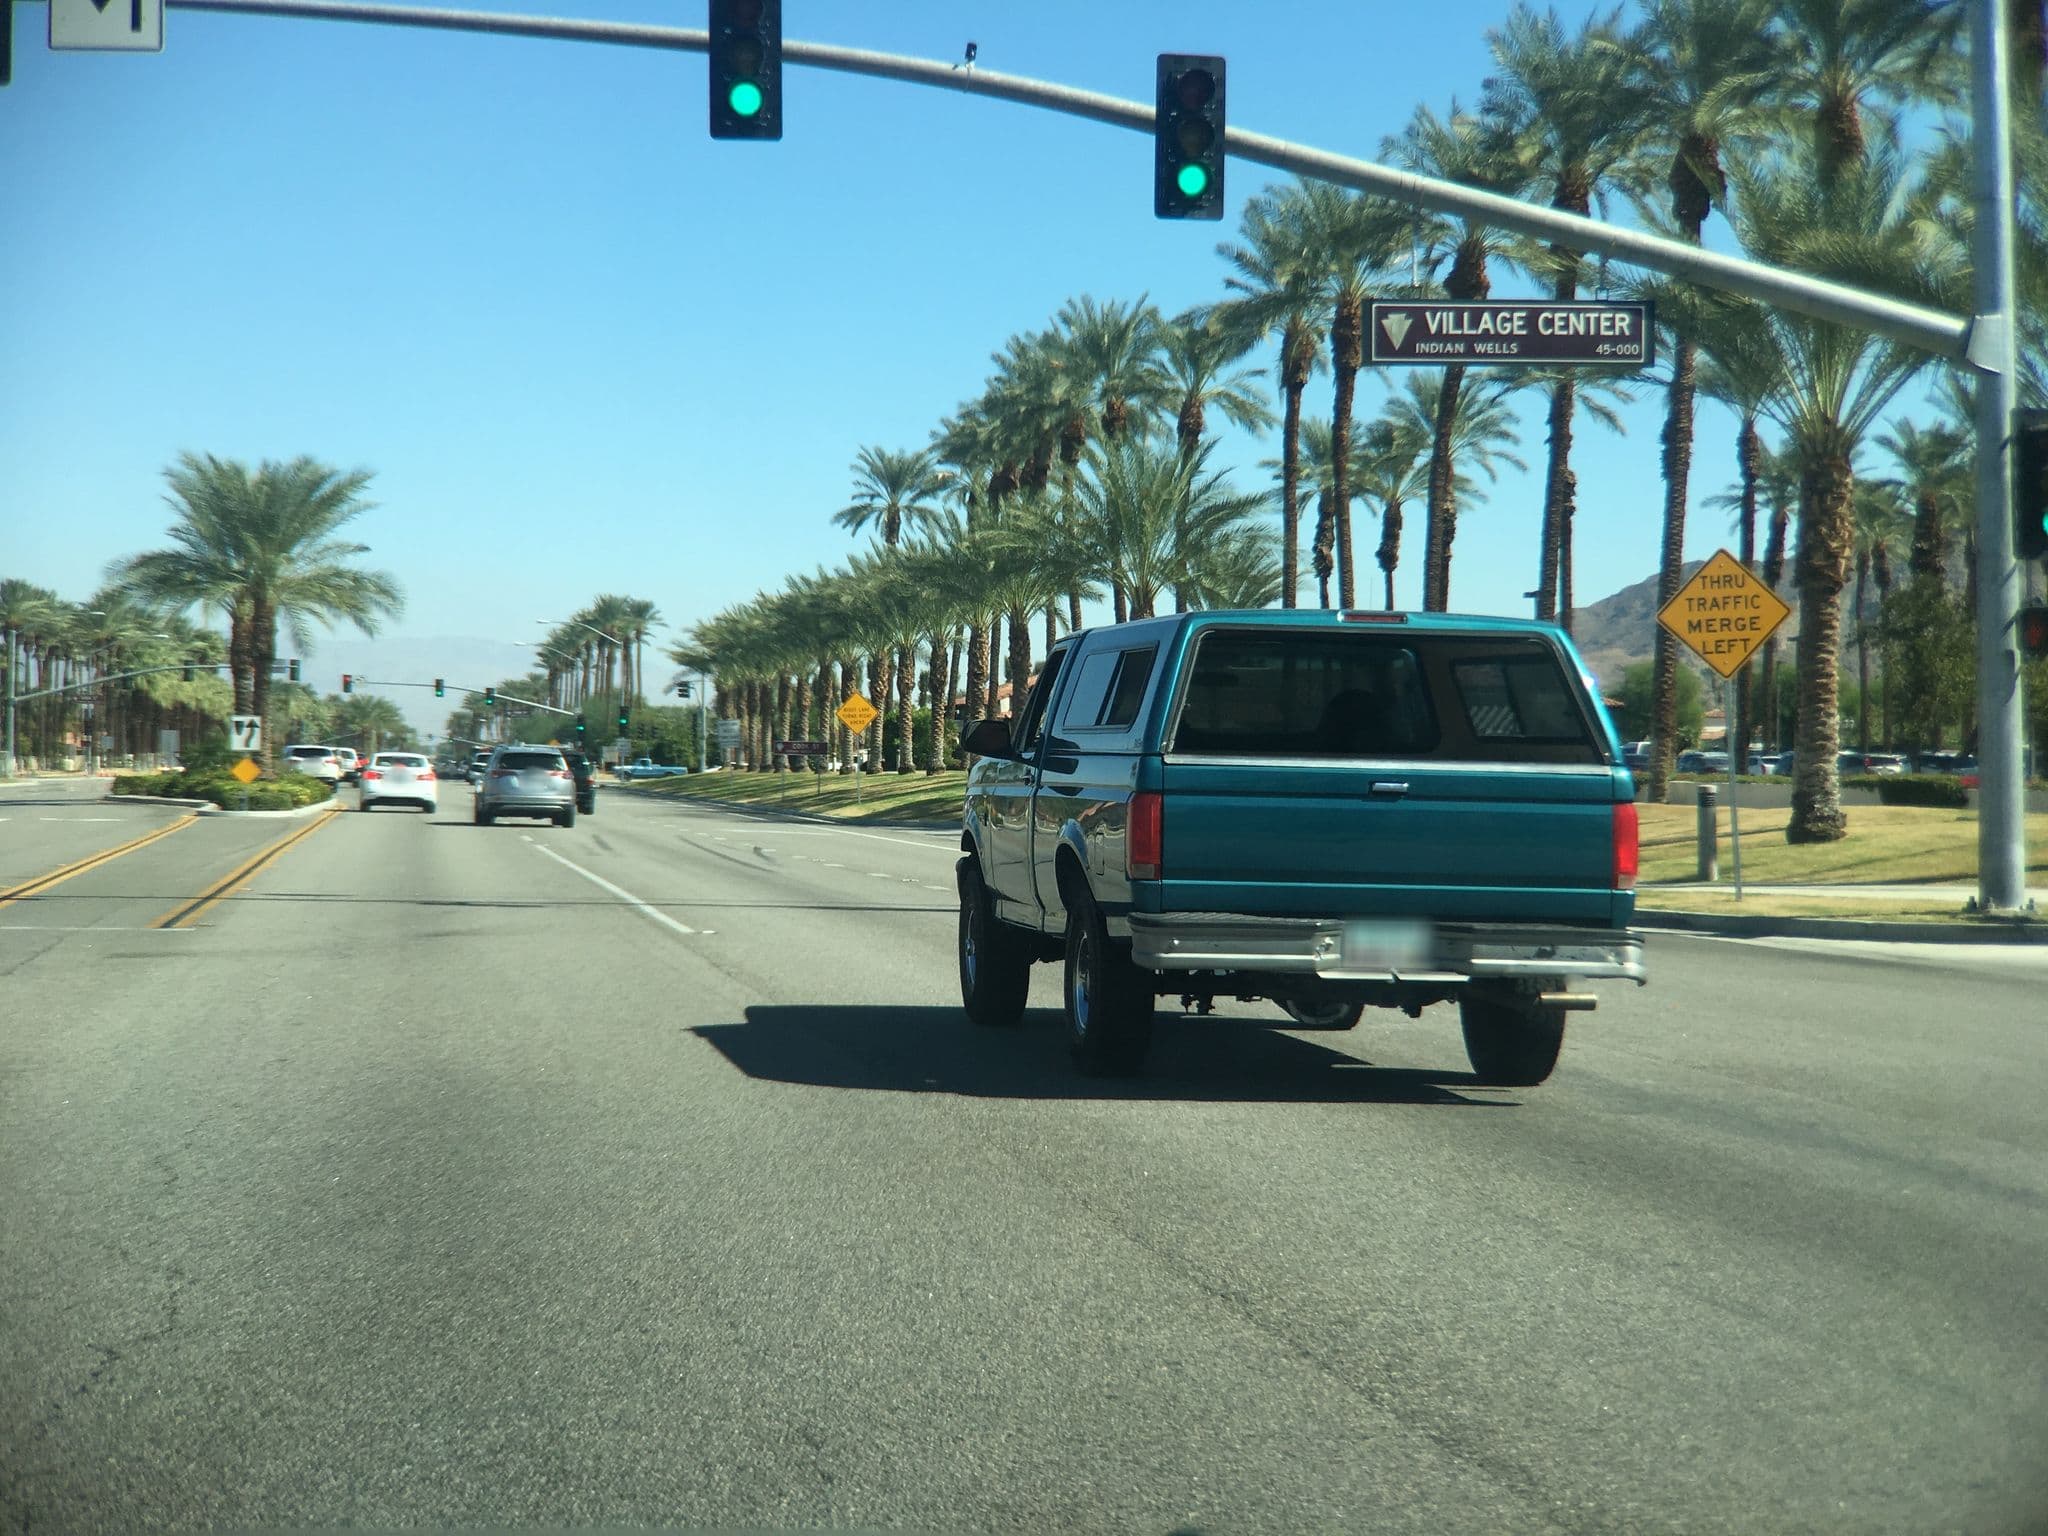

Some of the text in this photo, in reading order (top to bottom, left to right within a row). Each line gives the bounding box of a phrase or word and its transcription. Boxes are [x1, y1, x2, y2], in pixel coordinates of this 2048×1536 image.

[1425, 311, 1631, 336] VILLAGE CENTER
[1415, 343, 1518, 354] INDIAN WELLS
[1595, 344, 1640, 355] 45-000
[1699, 574, 1746, 590] THRU
[1685, 595, 1761, 612] TRAFFIC
[1687, 616, 1761, 634] MERGE
[1702, 638, 1751, 655] LEFT
